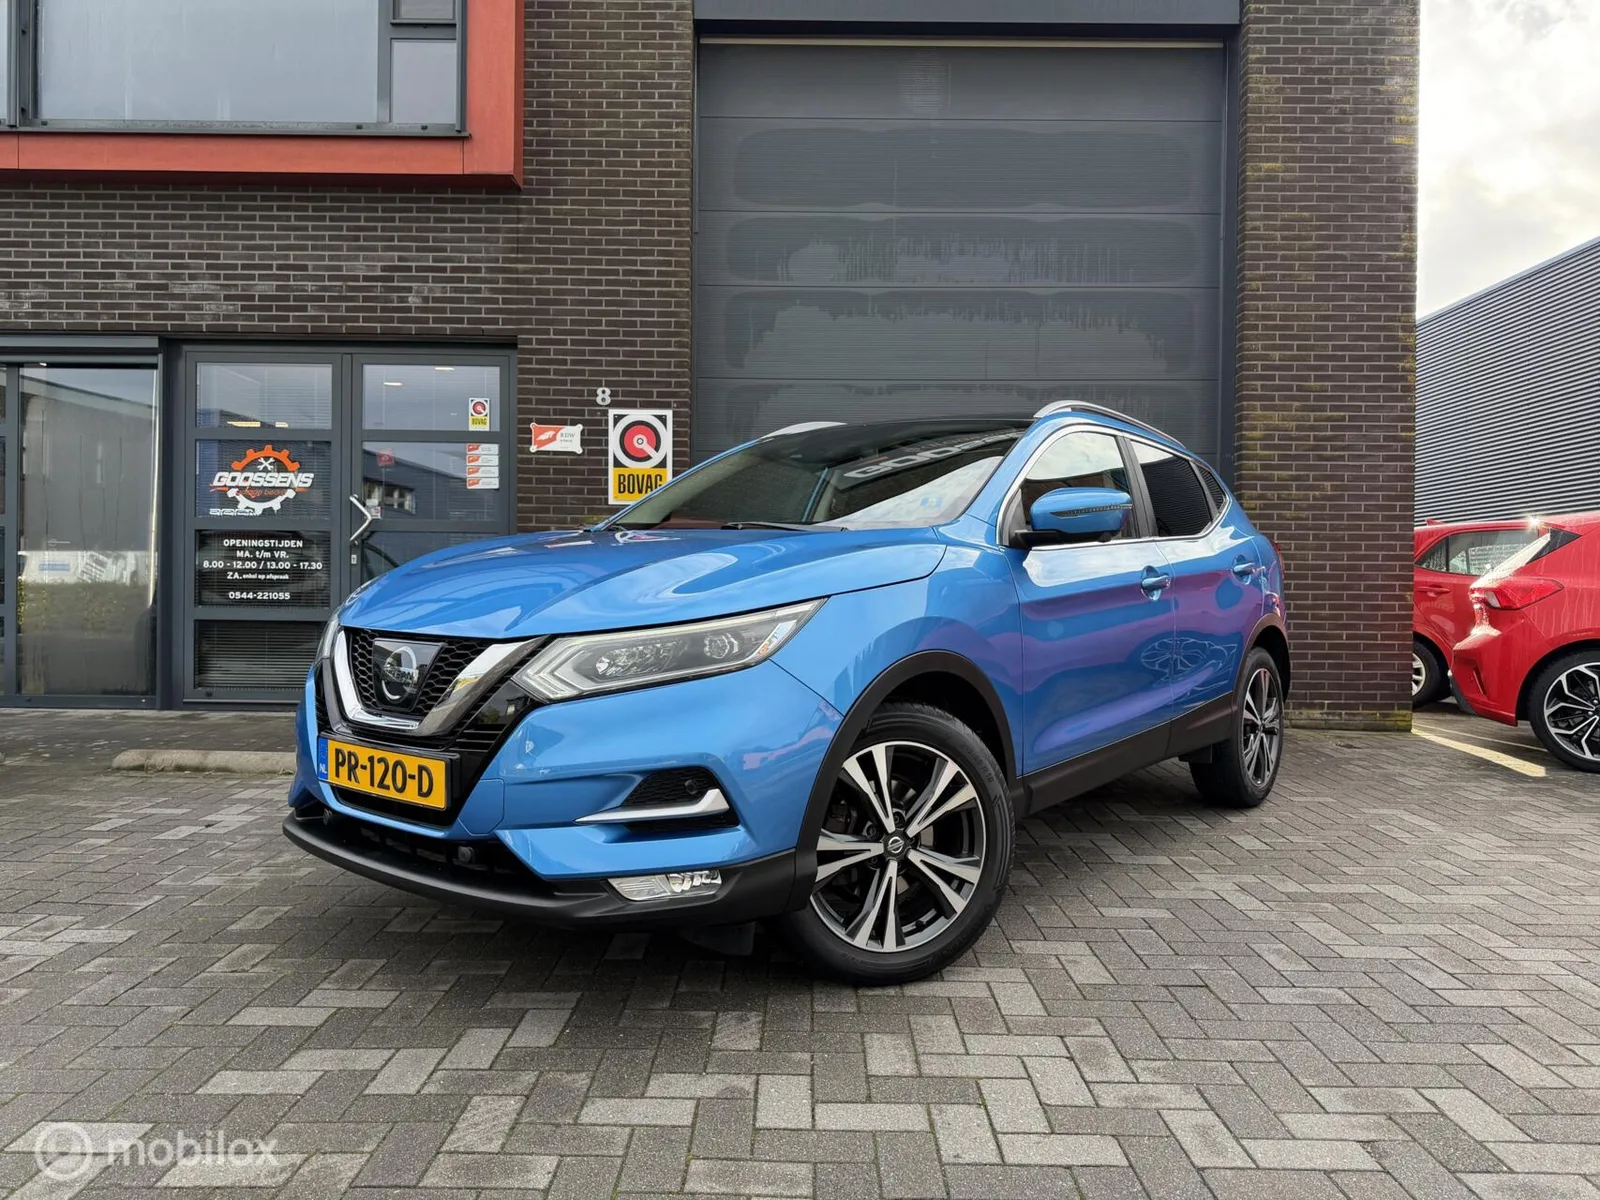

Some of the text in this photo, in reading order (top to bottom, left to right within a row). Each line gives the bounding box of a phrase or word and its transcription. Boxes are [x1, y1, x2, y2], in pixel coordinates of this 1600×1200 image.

[596, 387, 611, 406] 8
[213, 471, 315, 487] GOOSSENS
[223, 539, 303, 547] OPENINGSTIJDEN
[255, 550, 271, 558] t/m
[233, 561, 257, 569] 12.00
[266, 561, 291, 569] 13.00
[229, 592, 290, 600] 0544-221055
[334, 747, 434, 799] PR-120-D
